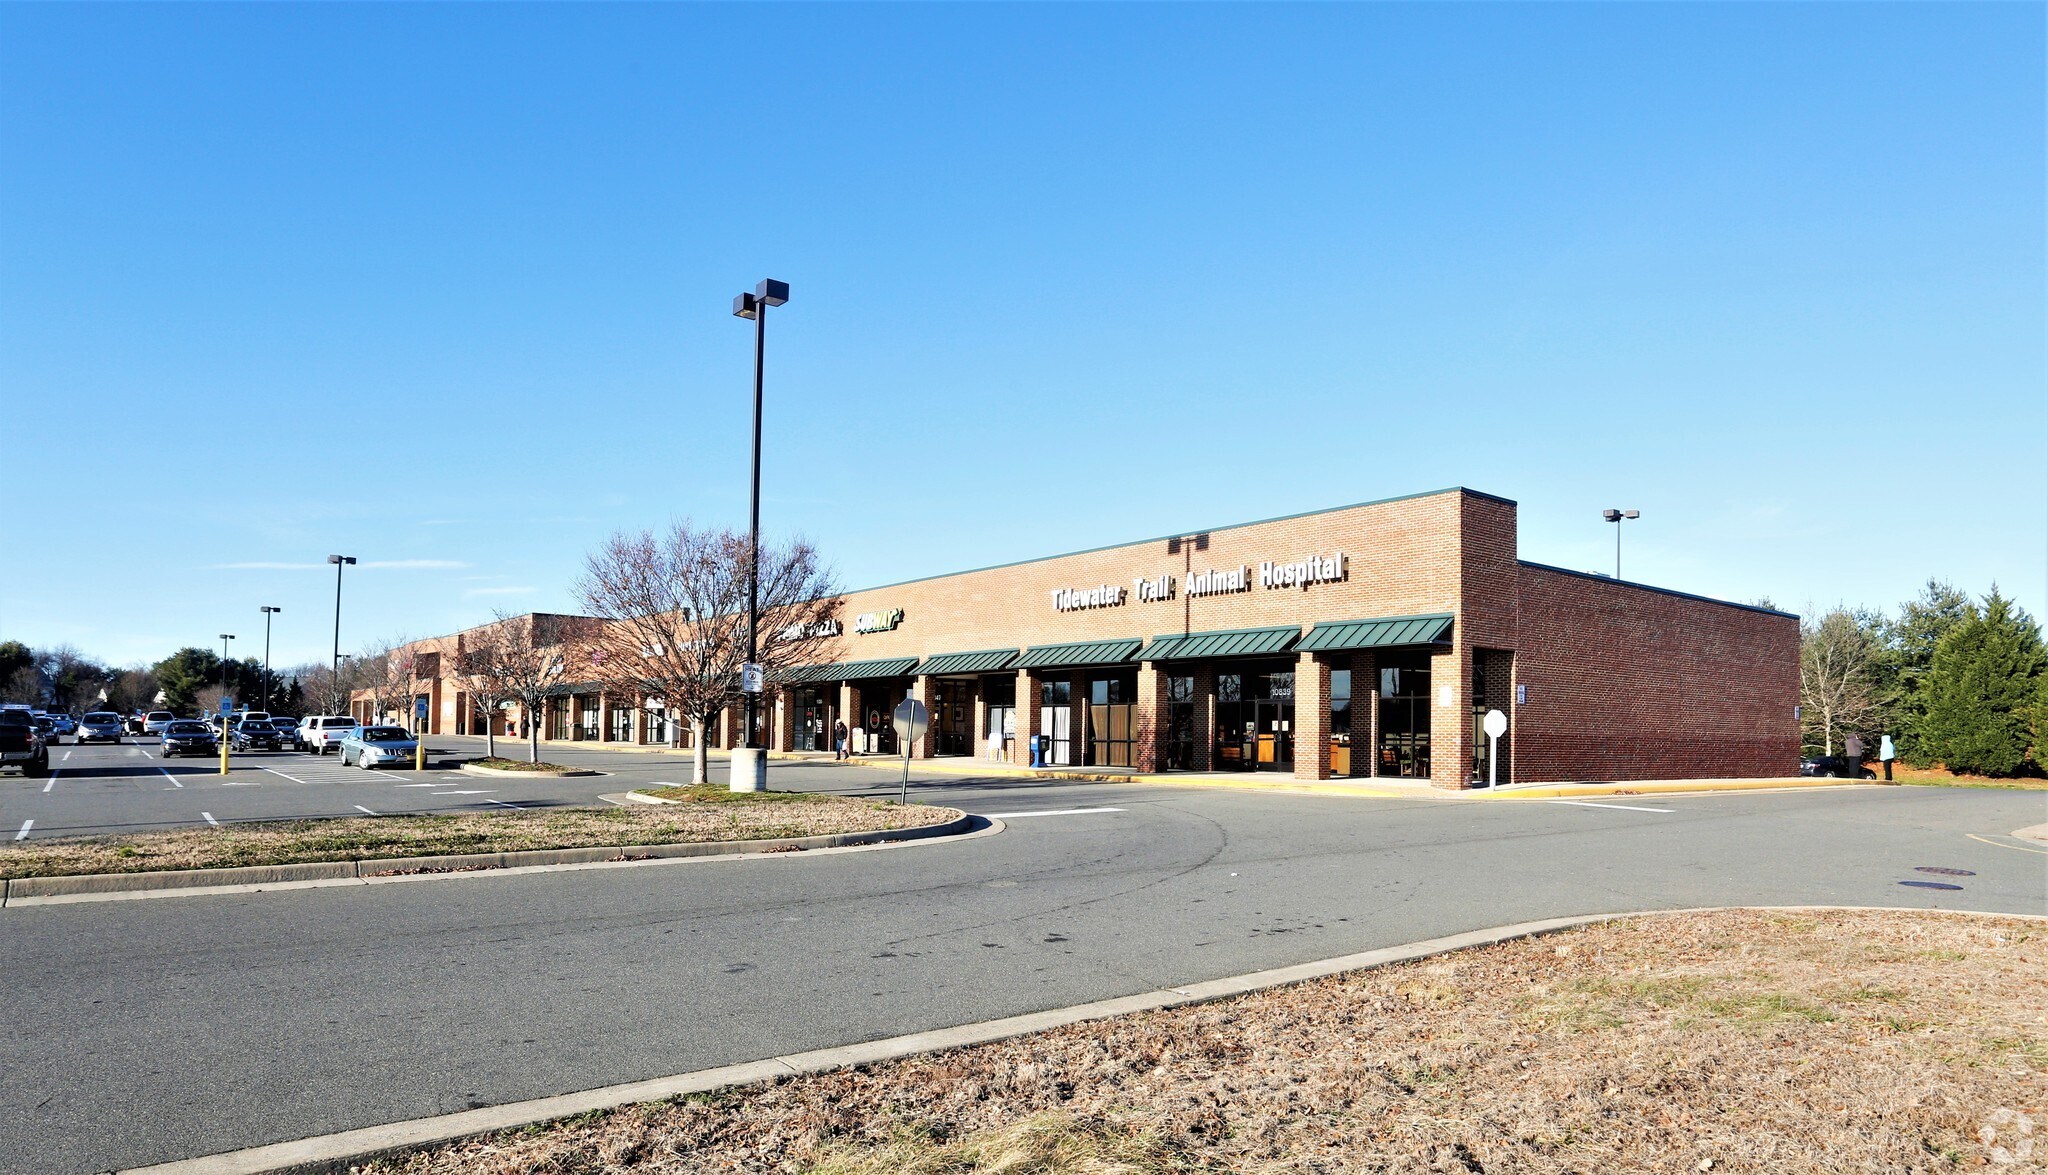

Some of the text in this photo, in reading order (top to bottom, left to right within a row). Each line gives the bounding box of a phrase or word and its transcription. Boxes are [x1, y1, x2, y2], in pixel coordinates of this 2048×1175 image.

[1051, 552, 1343, 609] Tidewater Trail Animal Hospital
[854, 608, 899, 632] SUBWAY
[1271, 688, 1291, 696] 10839
